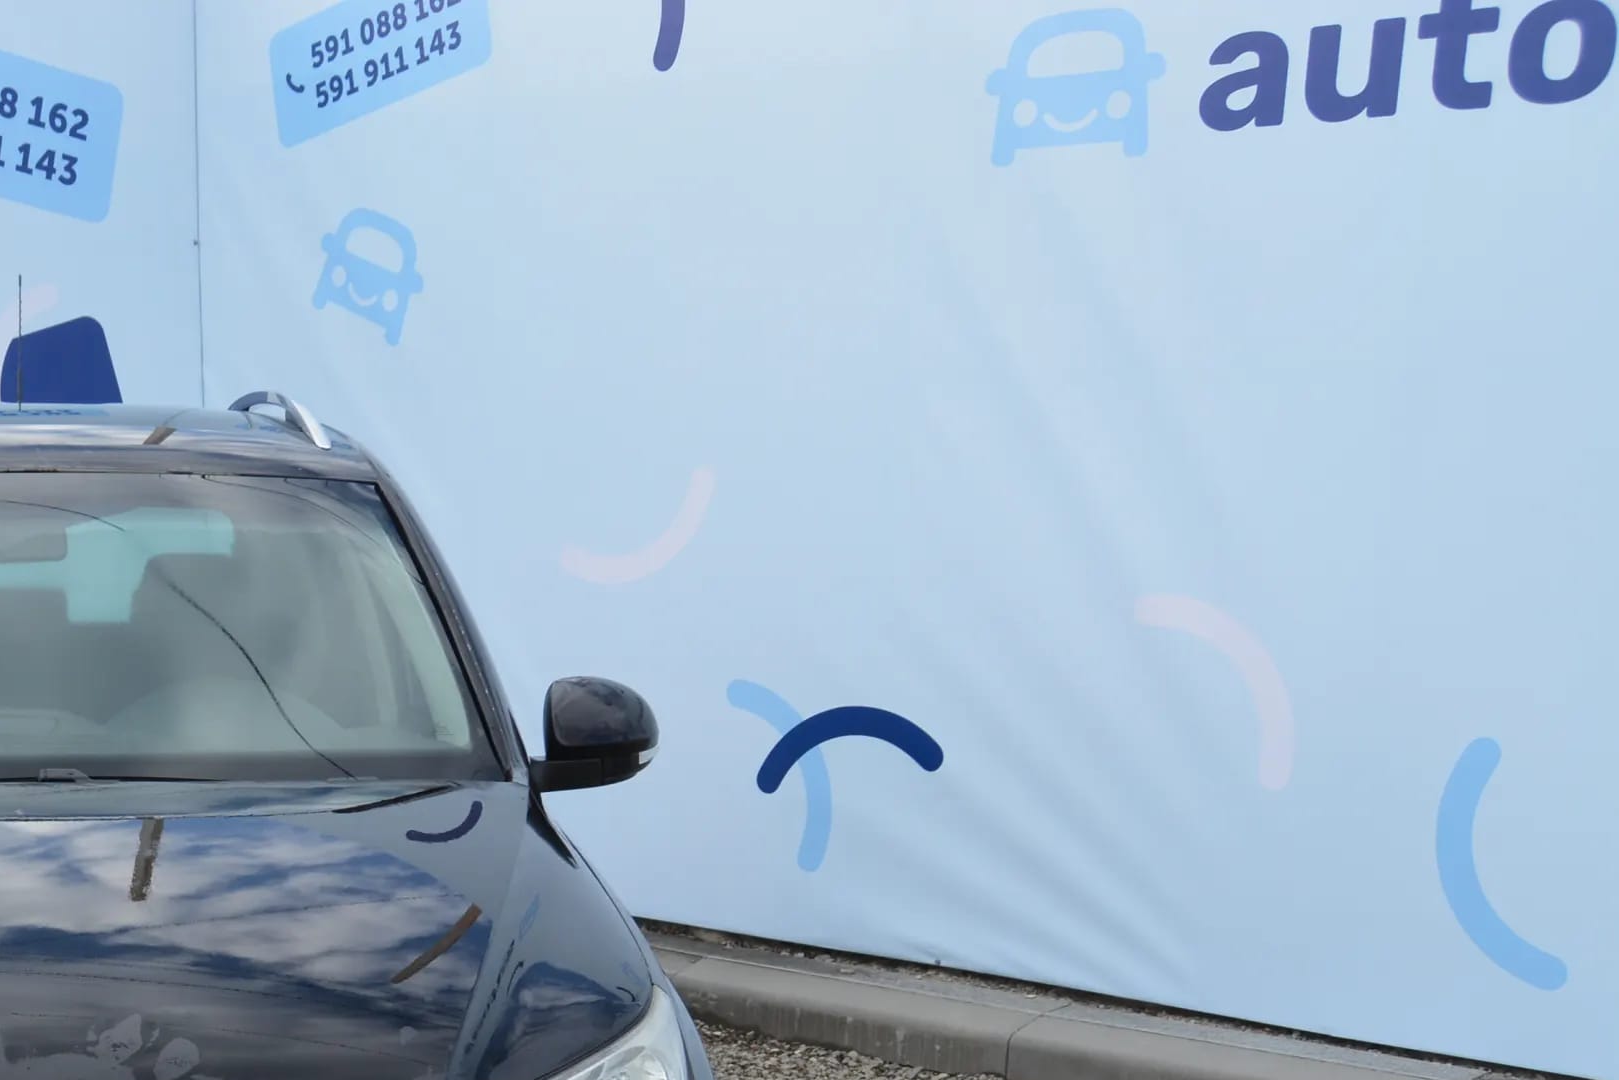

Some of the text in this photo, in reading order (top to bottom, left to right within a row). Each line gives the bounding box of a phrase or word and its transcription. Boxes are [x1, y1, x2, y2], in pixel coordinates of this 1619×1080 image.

[311, 0, 462, 68] 591 088 16
[315, 20, 462, 108] 591 911 143
[1199, 0, 1618, 132] auto
[27, 96, 89, 141] 162
[15, 143, 79, 186] 143
